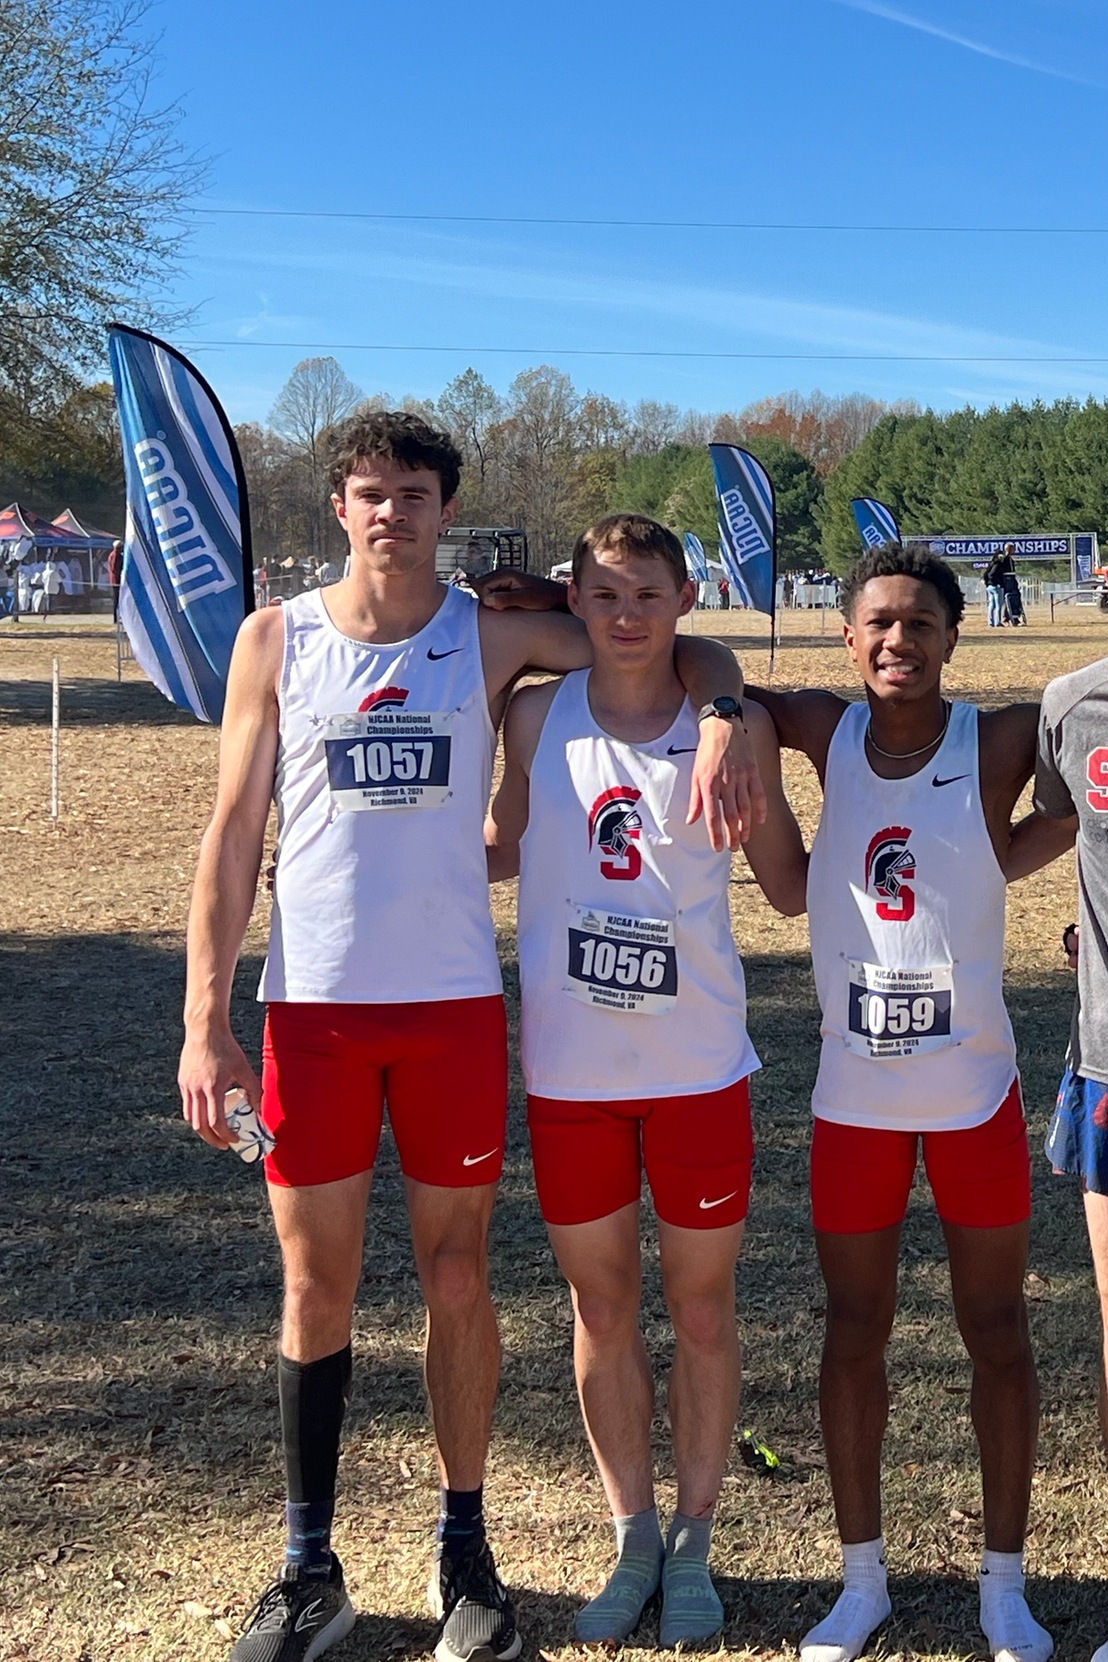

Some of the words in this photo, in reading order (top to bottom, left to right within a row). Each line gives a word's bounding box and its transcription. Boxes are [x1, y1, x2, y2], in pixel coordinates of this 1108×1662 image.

[946, 540, 1067, 554] CHAMPINSHIPS
[368, 715, 394, 724] NJCAA
[396, 715, 431, 724] National
[367, 725, 434, 735] Championships
[346, 741, 434, 783] 1057
[362, 788, 399, 798] November
[607, 916, 632, 928] NJCAA
[634, 920, 668, 933] National
[604, 926, 668, 943] Championships
[579, 938, 667, 988] 1056
[875, 970, 897, 980] NJCAA
[898, 971, 932, 981] National
[873, 980, 934, 991] Championships
[858, 993, 935, 1034] 1059
